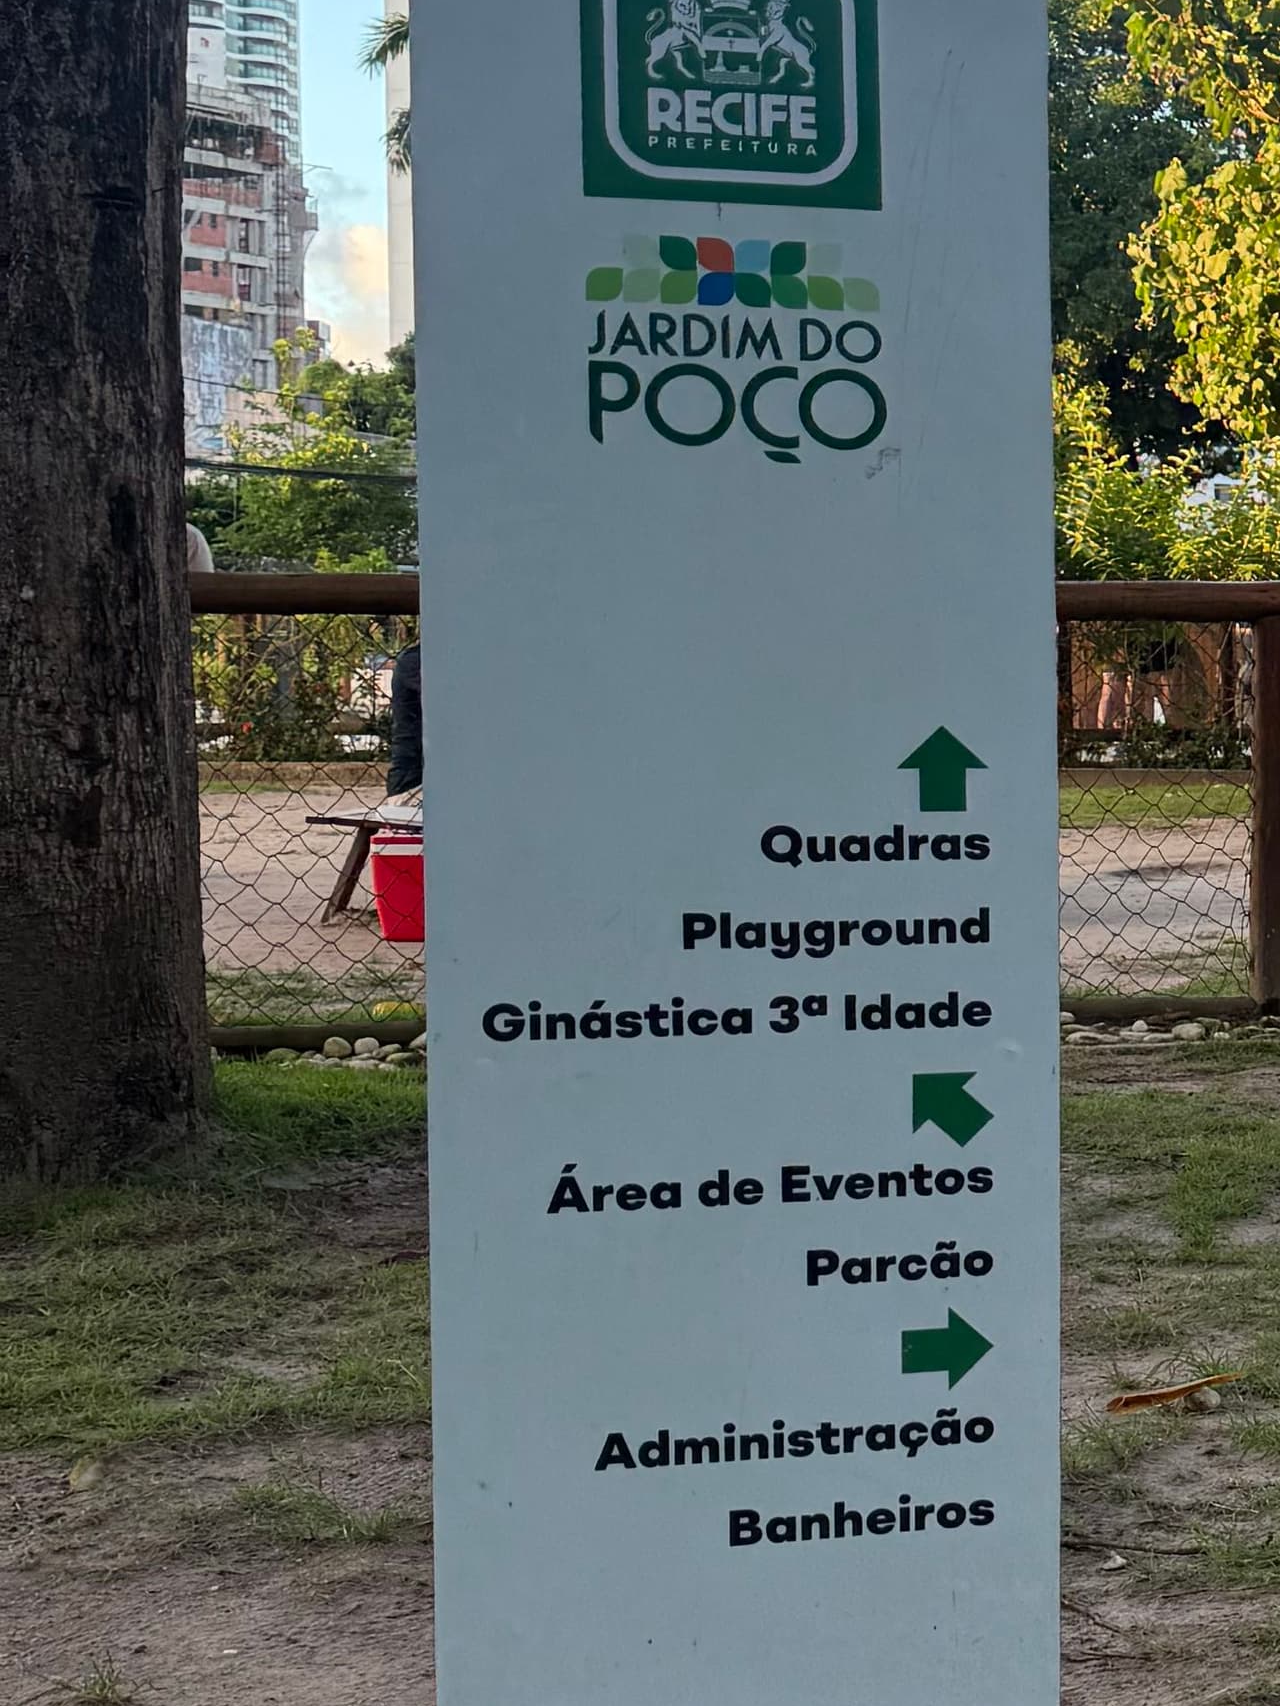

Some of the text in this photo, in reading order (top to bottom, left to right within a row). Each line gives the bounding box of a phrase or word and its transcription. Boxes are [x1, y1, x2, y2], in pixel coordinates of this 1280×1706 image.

[648, 87, 817, 139] RECIFE
[649, 135, 818, 156] PREFEITURA
[588, 309, 882, 364] JARDIM DO
[588, 360, 887, 463] POÇO
[761, 824, 990, 867] Quadras
[682, 906, 990, 959] Playground
[482, 991, 993, 1042] Ginástica 3ª Idade
[547, 1164, 993, 1214] Área de Eventos
[806, 1240, 994, 1286] Parcão
[594, 1407, 994, 1471] Administração
[729, 1493, 995, 1547] Banheiros
